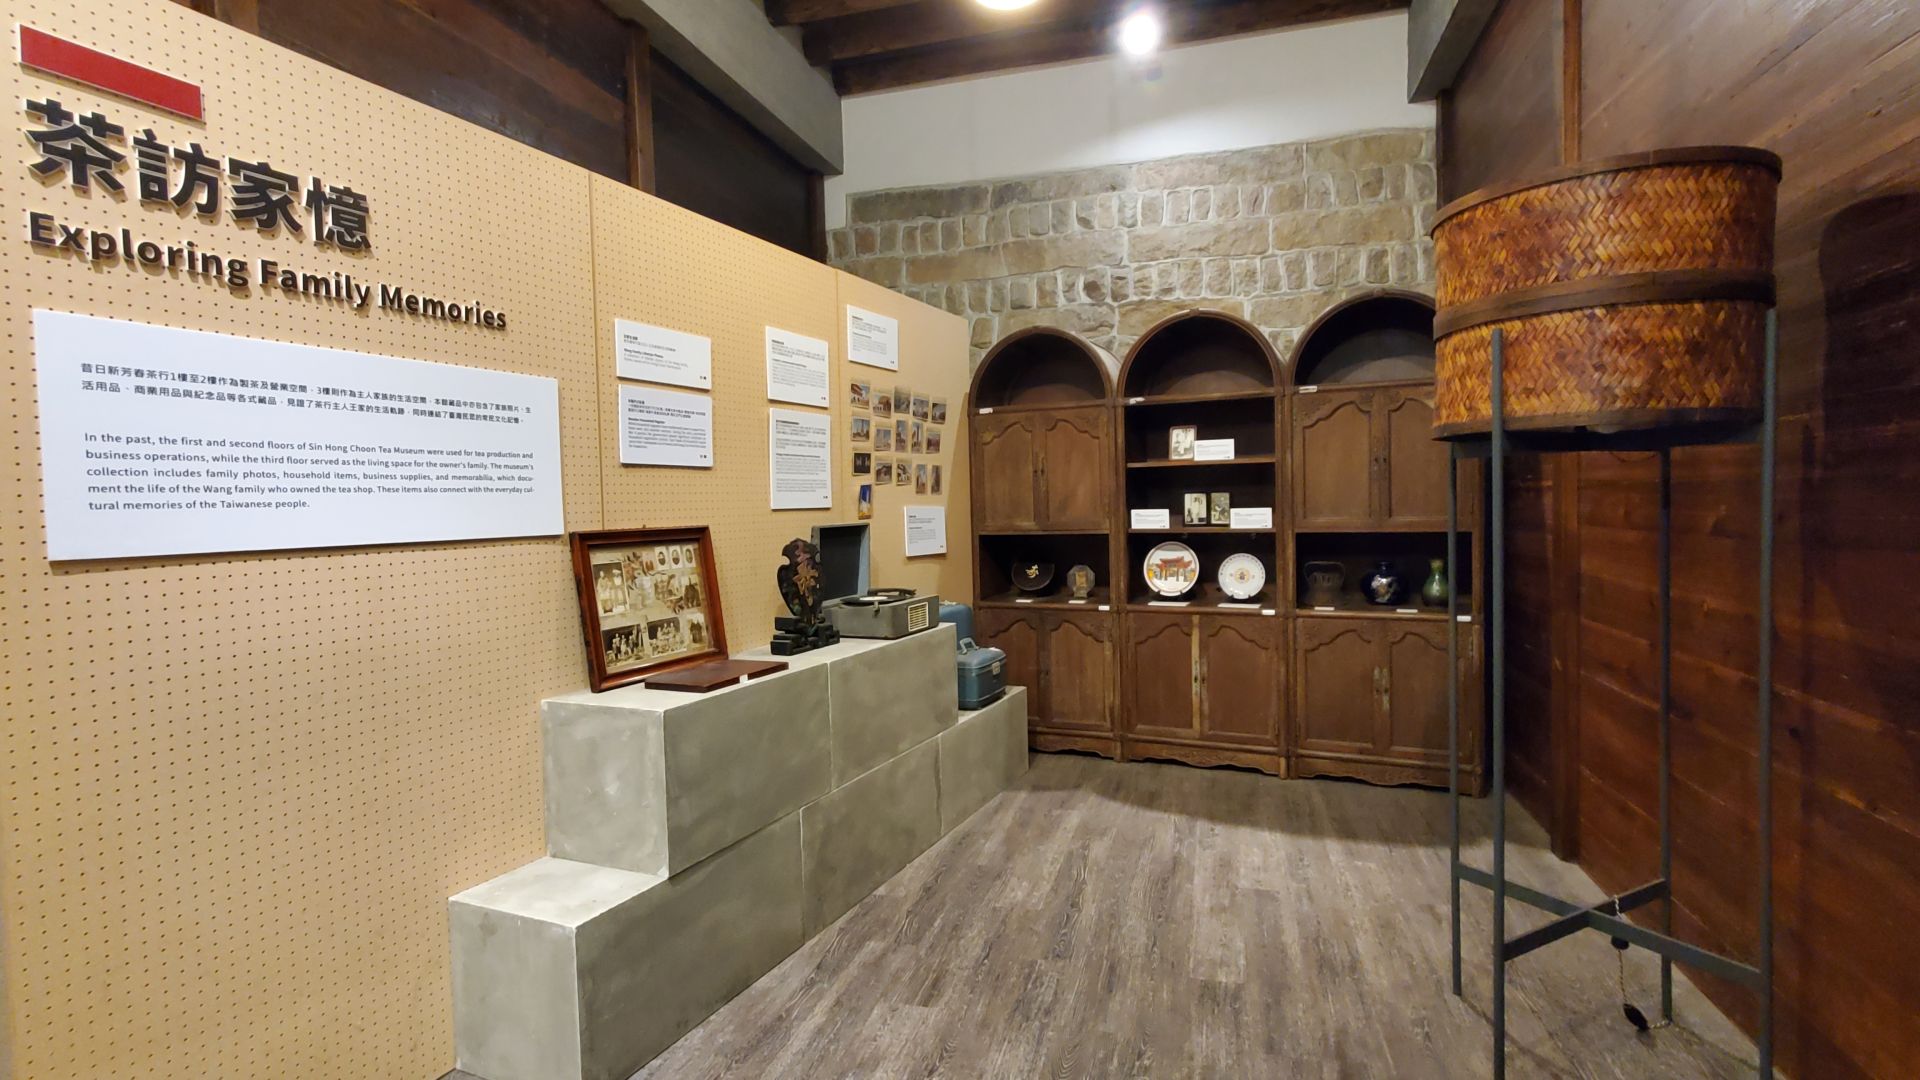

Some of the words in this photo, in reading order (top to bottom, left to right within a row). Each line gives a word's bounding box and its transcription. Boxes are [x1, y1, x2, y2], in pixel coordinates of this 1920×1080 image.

[25, 98, 372, 250] 茶訪家憶
[29, 211, 249, 287] Exploring
[258, 258, 371, 308] Family
[378, 282, 507, 329] Memories
[84, 432, 97, 442] In
[101, 433, 122, 443] the
[126, 435, 155, 445] past,
[159, 436, 178, 445] the
[181, 437, 203, 446] first
[206, 438, 226, 447] and
[229, 440, 265, 449] second
[267, 440, 295, 450] floors
[297, 442, 306, 450] of
[308, 443, 323, 451] Sin
[325, 444, 348, 453] Hong
[350, 444, 376, 453] Choon
[394, 447, 425, 455] Museum
[486, 451, 521, 459] production
[86, 449, 141, 460] business
[144, 452, 209, 463] operations,
[211, 454, 240, 463] while
[242, 455, 259, 463] the
[261, 455, 284, 464] third
[287, 456, 308, 464] floor
[310, 457, 339, 466] served
[352, 458, 366, 466] the
[367, 459, 389, 468] living
[414, 460, 425, 468] for
[467, 462, 489, 470] family.
[87, 467, 149, 477] collection
[154, 468, 202, 478] includes
[206, 469, 239, 480] family
[243, 470, 280, 480] photos,
[283, 471, 331, 479] household
[334, 472, 360, 480] items,
[363, 472, 397, 480] business
[400, 473, 433, 481] supplies,
[451, 474, 495, 482] memorabilia,
[88, 485, 121, 493] ment
[124, 484, 145, 493] the
[147, 484, 166, 493] life
[168, 484, 180, 493] of
[182, 484, 201, 493] the
[203, 485, 232, 495] Wang
[234, 485, 265, 495] family
[268, 485, 288, 493] who
[290, 485, 320, 493] owned
[322, 485, 336, 493] the
[353, 485, 375, 494] shop.
[89, 501, 119, 510] tural
[123, 500, 183, 510] memories
[185, 500, 197, 509] of
[199, 500, 217, 509] the
[220, 500, 273, 508] Taiwanese
[275, 499, 310, 509] people.
